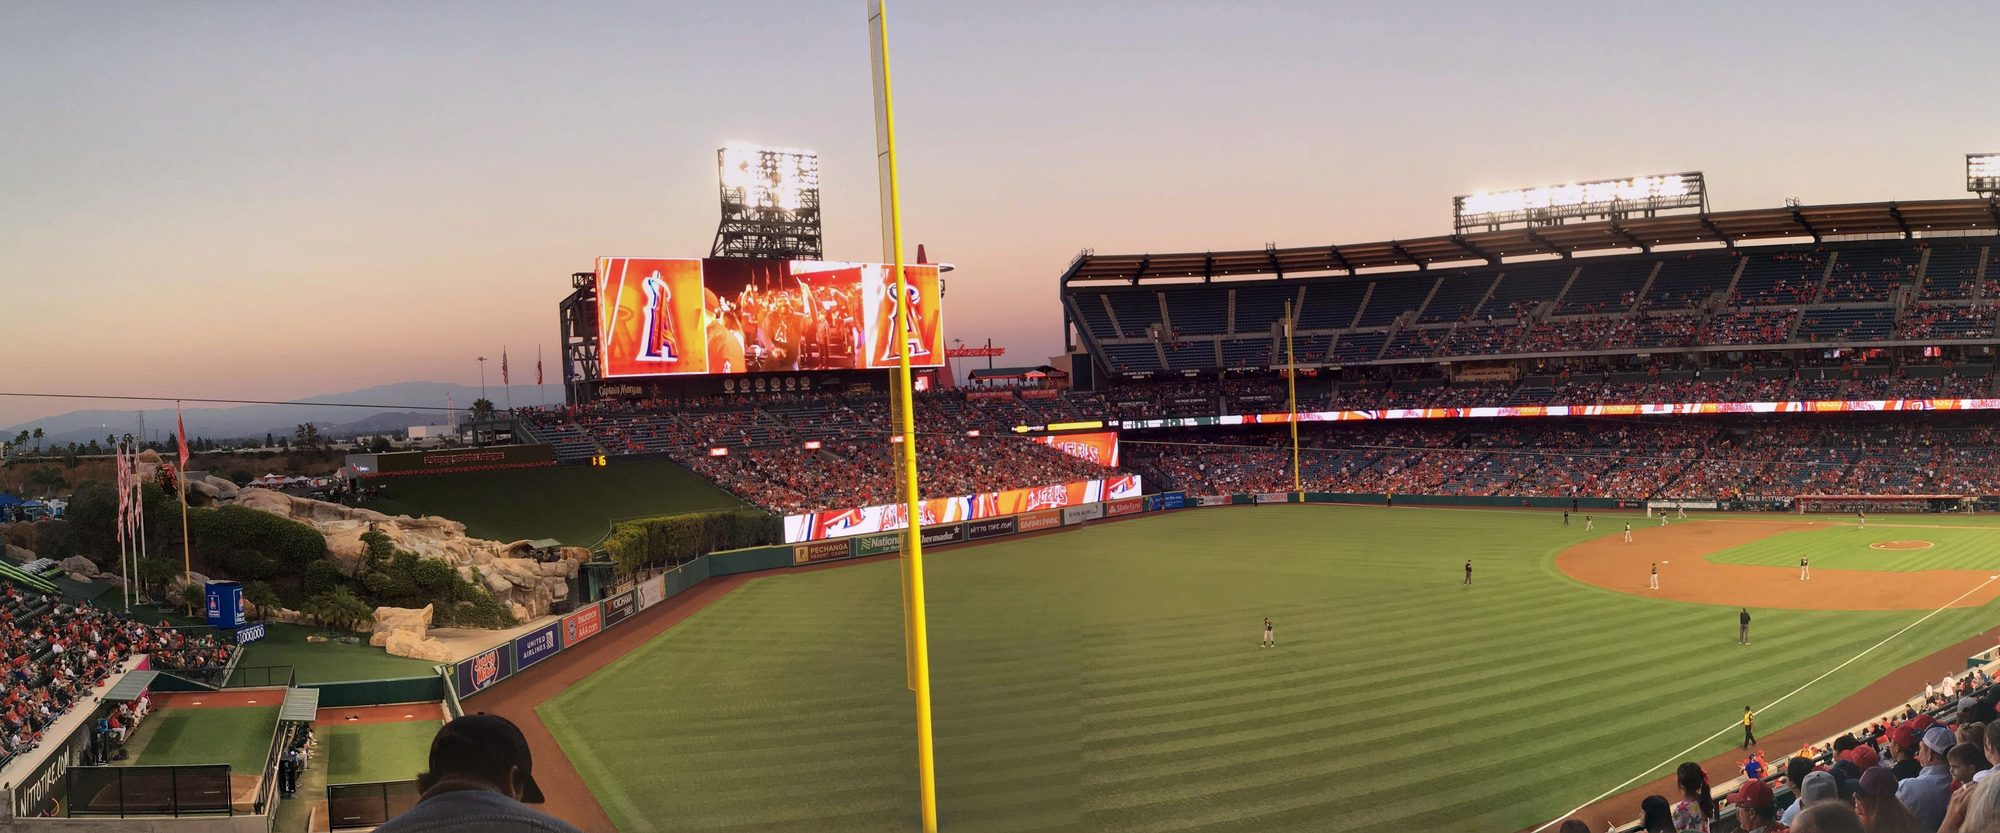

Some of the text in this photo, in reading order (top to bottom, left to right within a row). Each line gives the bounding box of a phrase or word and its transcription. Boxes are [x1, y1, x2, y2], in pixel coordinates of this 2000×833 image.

[620, 384, 643, 396] Morgan
[810, 543, 848, 555] PECHANGA
[577, 610, 597, 623] Insurance
[526, 634, 546, 649] UNITED
[523, 643, 547, 659] AIRLINES
